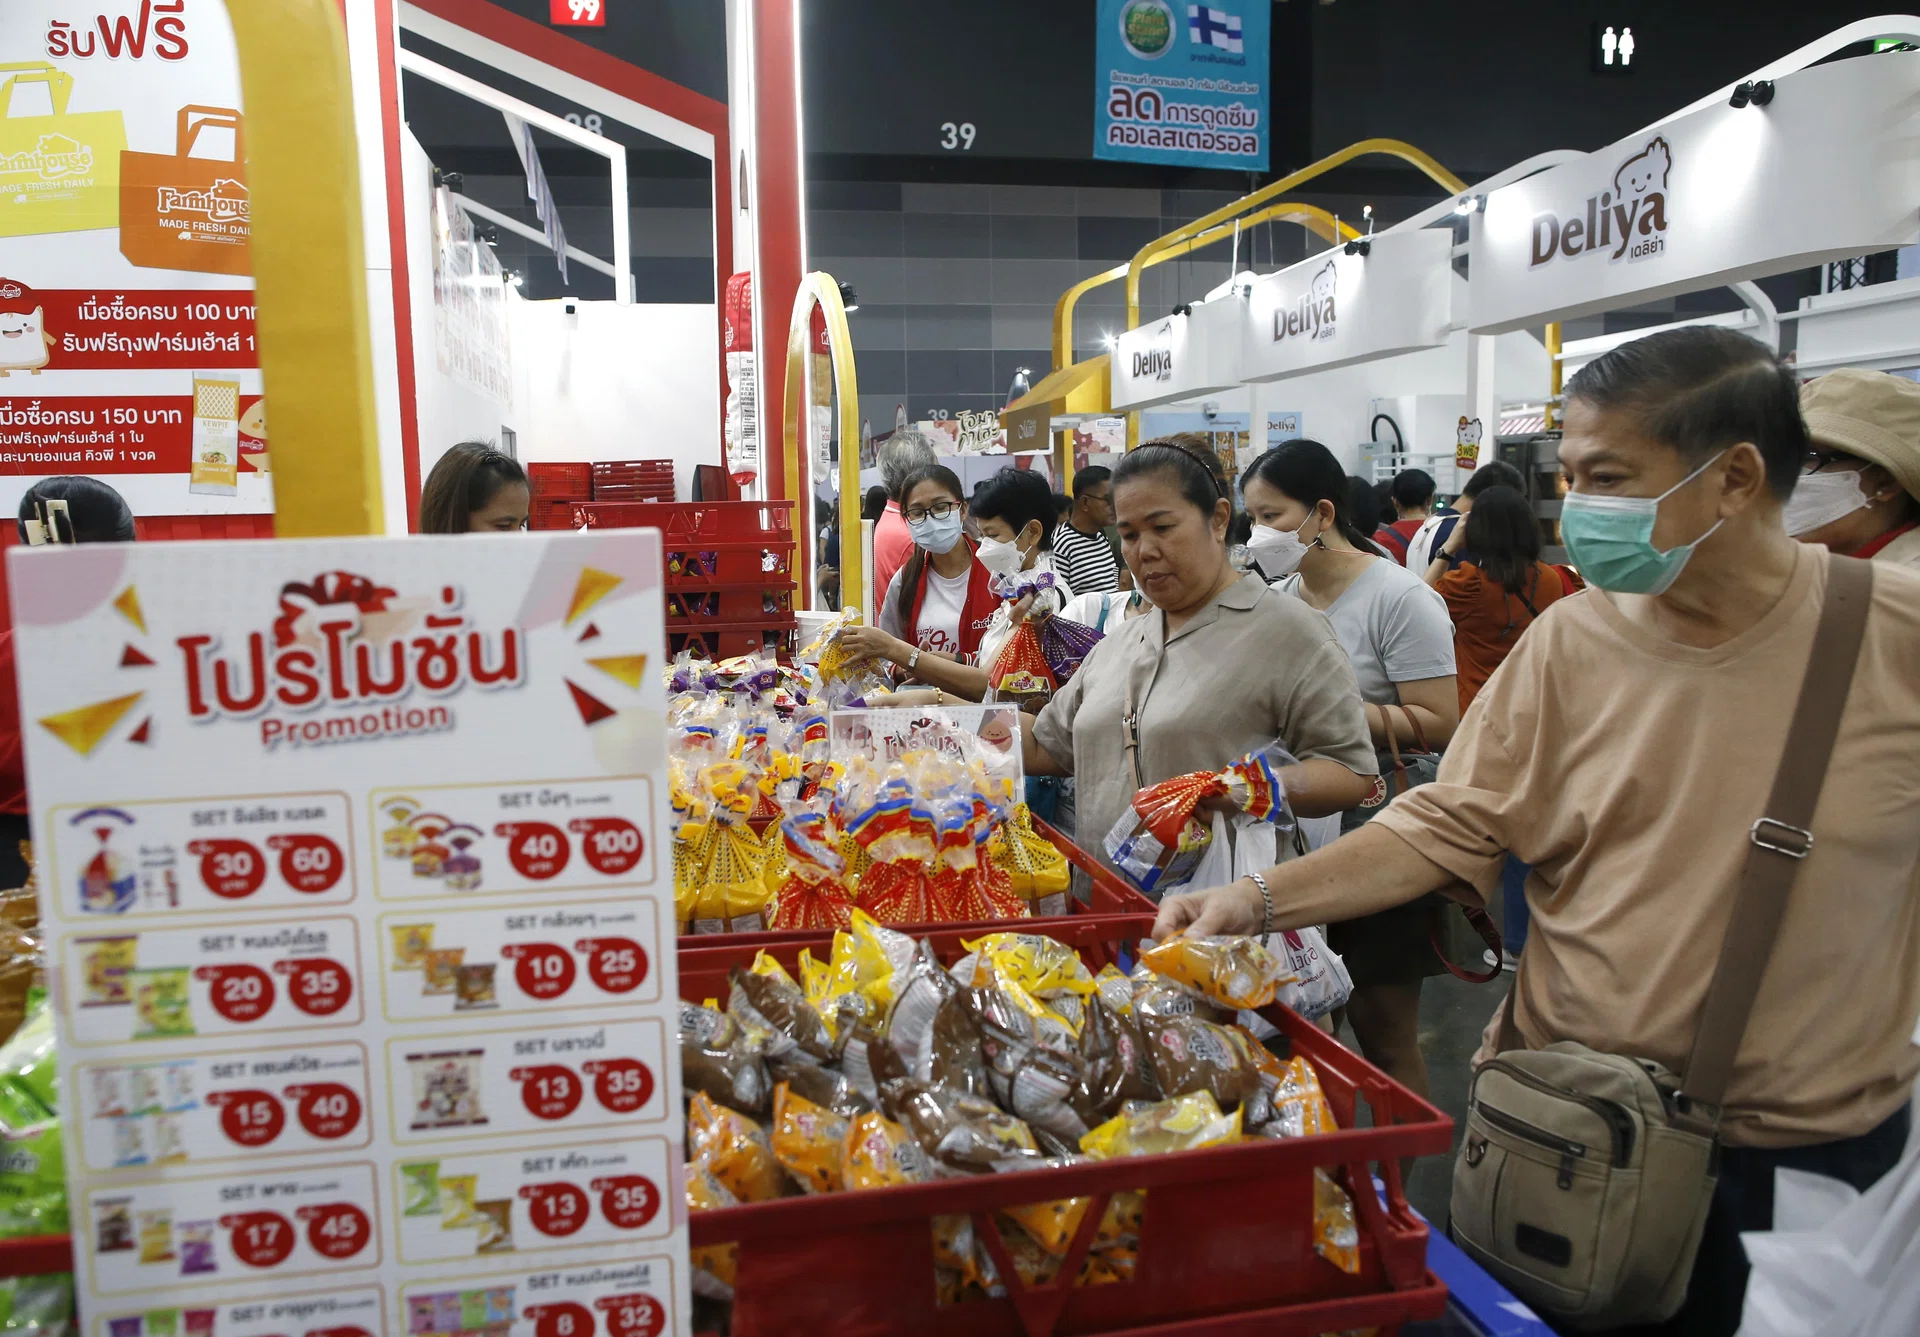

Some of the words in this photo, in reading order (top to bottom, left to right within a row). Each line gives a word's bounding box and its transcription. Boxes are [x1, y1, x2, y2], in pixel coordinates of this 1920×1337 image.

[1189, 79, 1194, 88] 2
[1110, 88, 1161, 121] ลด
[940, 122, 976, 150] 39
[1110, 125, 1257, 153] คอเลสเตอรอล
[26, 181, 61, 192] FRESH
[64, 178, 94, 188] DAILY
[159, 219, 190, 230] MADE
[193, 222, 227, 233] FRESH
[1531, 191, 1668, 267] Deliya
[1630, 235, 1664, 259] เดลิย่า
[78, 295, 177, 321] เมื่อซื้อครบ
[184, 303, 220, 321] 100
[1274, 294, 1336, 342] Deliya
[63, 332, 240, 358] รับฟรีถุงฟาร์มเฮ้าส์
[246, 336, 255, 352] 1
[1133, 348, 1171, 380] Deliya
[101, 408, 138, 425] 150
[144, 409, 182, 425] บาท
[203, 421, 229, 429] KEWPIE
[119, 433, 126, 444] 1
[130, 430, 144, 443] ใบ
[85, 448, 114, 462] คิวพี
[119, 451, 126, 462] 1
[130, 451, 156, 461] ขวด
[176, 585, 519, 716] โปรโมชั่น
[260, 705, 450, 746] Promotion
[499, 793, 533, 809] SET
[192, 808, 226, 826] SET
[521, 835, 557, 858] 40
[594, 830, 638, 854] 100
[213, 852, 254, 877] 30
[292, 847, 331, 872] 60
[505, 915, 537, 930] SET
[201, 936, 236, 952] SET
[529, 955, 563, 979] 10
[601, 949, 637, 973] 25
[223, 977, 262, 1001] 20
[301, 970, 340, 995] 35
[514, 1038, 547, 1055] SET
[211, 1063, 246, 1079] SET
[536, 1076, 570, 1099] 13
[607, 1069, 642, 1094] 35
[234, 1102, 272, 1126] 15
[310, 1094, 348, 1118] 40
[522, 1158, 554, 1174] SET
[220, 1185, 255, 1201] SET
[545, 1194, 578, 1218] 13
[613, 1186, 648, 1210] 35
[245, 1222, 282, 1246] 17
[320, 1214, 357, 1238] 45
[528, 1273, 560, 1291] SET
[231, 1305, 265, 1322] SET
[557, 1313, 575, 1336] 8
[619, 1306, 653, 1328] 32
